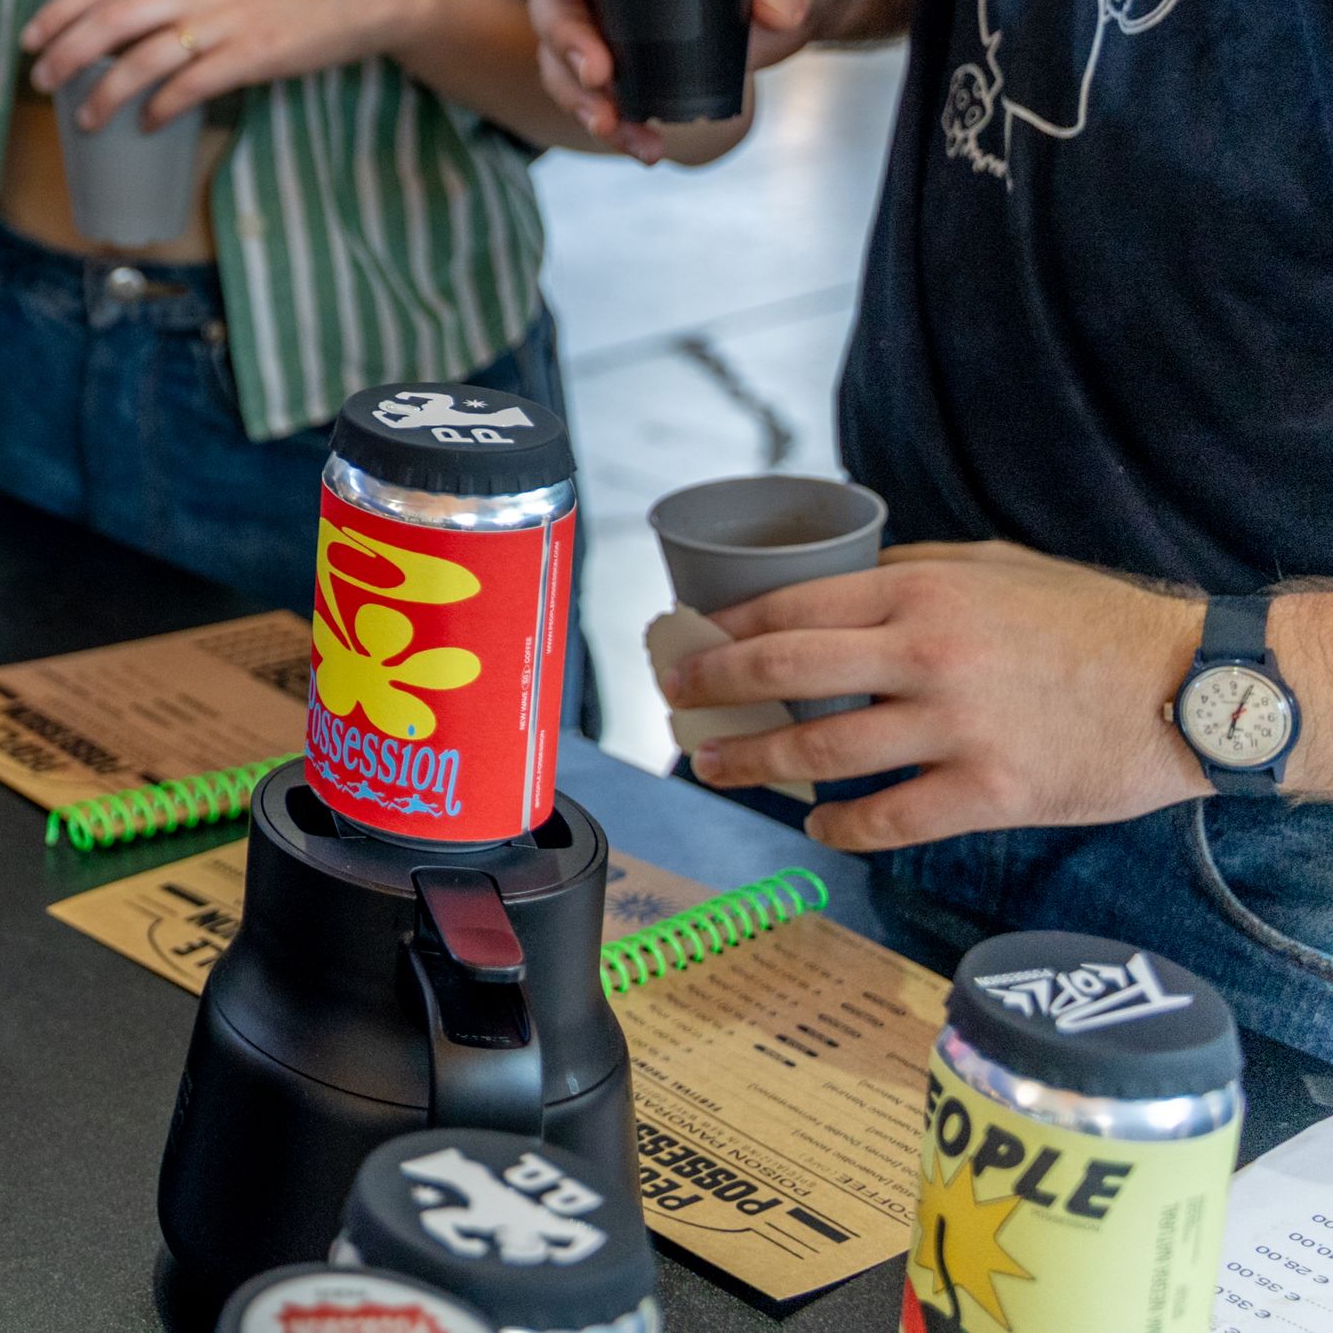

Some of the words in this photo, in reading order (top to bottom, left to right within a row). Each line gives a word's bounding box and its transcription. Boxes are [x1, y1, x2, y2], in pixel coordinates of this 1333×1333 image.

[518, 712, 526, 730] NEW
[523, 635, 532, 663] COFFEE
[670, 1079, 722, 1113] FESTIVAL
[746, 1079, 823, 1129] Fermentation]
[630, 1092, 726, 1149] PANORAM
[791, 1126, 833, 1155] Honey]
[821, 1121, 860, 1149] Double
[865, 1122, 917, 1157] [Natural]
[635, 1122, 783, 1217] POSSESS
[729, 1149, 811, 1197] POISON
[831, 1148, 892, 1189] [Anaerobic
[834, 1170, 913, 1222] COFFEE
